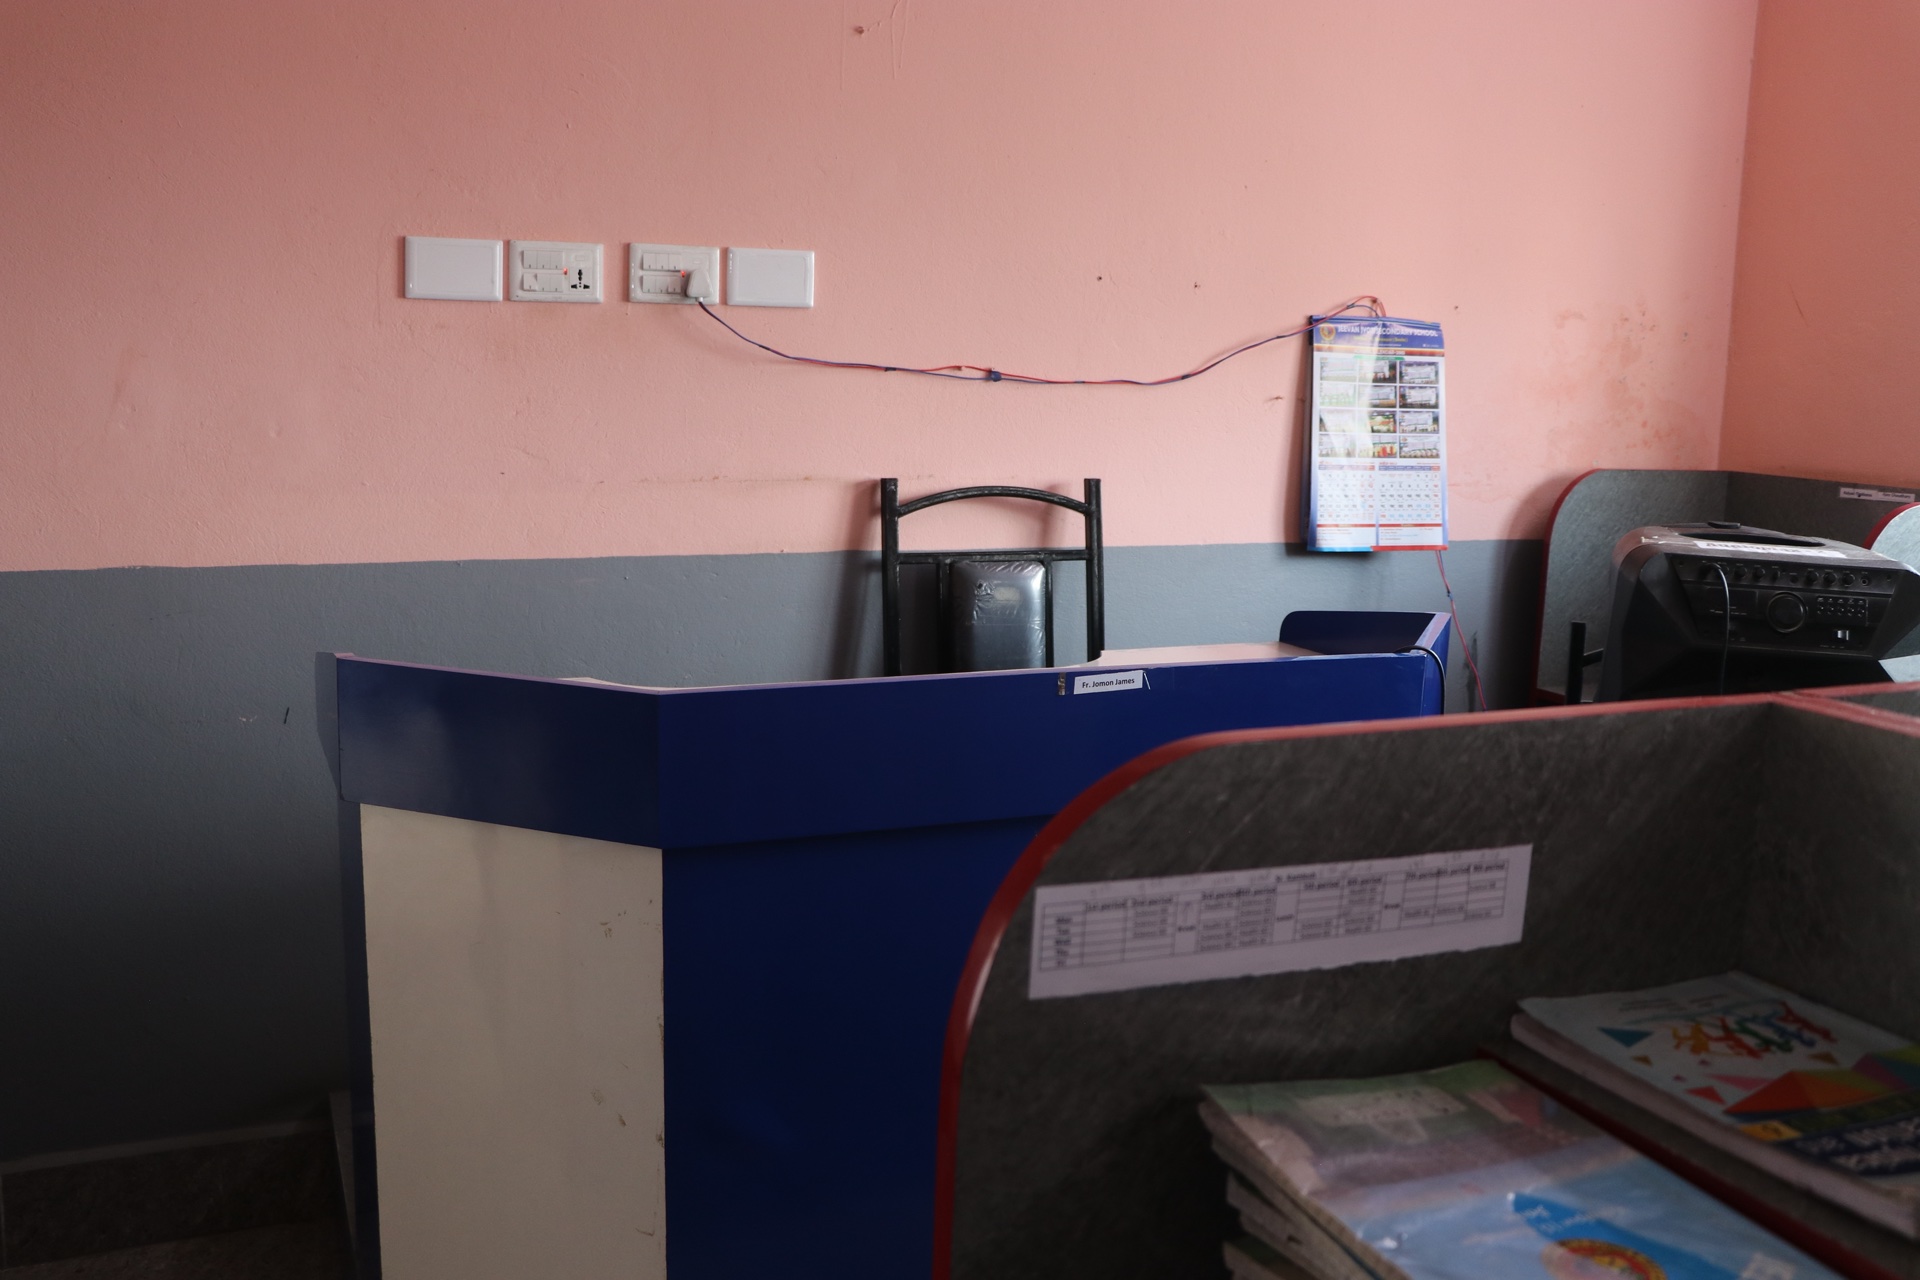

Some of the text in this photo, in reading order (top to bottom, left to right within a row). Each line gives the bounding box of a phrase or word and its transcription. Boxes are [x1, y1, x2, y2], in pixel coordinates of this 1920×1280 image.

[1338, 325, 1360, 333] JEEVAN
[1082, 678, 1135, 689] Fr. Jomon James
